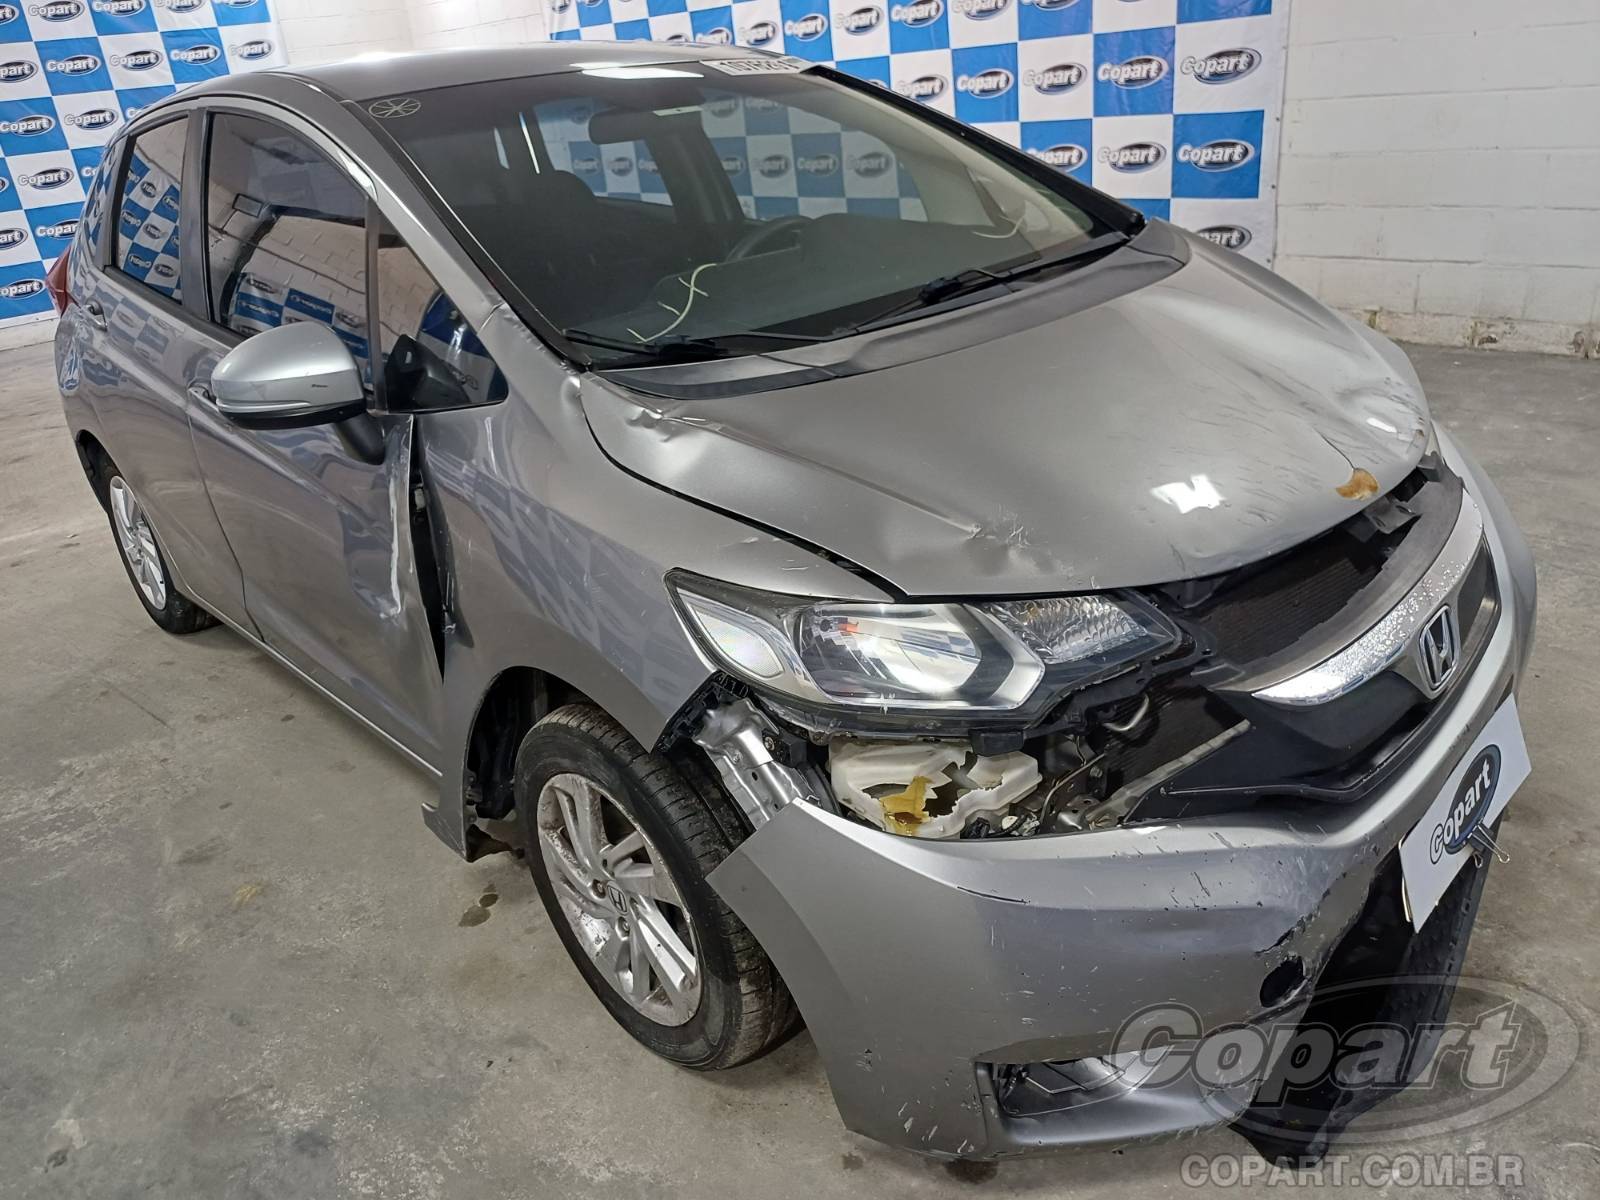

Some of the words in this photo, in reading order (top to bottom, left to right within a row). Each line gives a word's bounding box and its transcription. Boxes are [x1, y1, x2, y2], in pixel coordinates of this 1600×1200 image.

[28, 3, 77, 17] Copart
[891, 2, 939, 24] Copart
[784, 17, 823, 39] Copart
[110, 53, 159, 69] Copart
[170, 47, 216, 62] Copart
[46, 58, 95, 73] Copart
[1097, 59, 1158, 82] Copart
[1181, 51, 1251, 77] Copart
[956, 74, 1007, 94] Copart
[1022, 67, 1079, 88] Copart
[0, 118, 49, 134] Copart
[64, 111, 112, 127] Copart
[1098, 144, 1158, 166] Copart
[1177, 144, 1245, 165] Copart
[19, 171, 68, 187] Copart
[36, 222, 78, 237] Copar
[0, 280, 41, 297] opart
[1430, 758, 1490, 865] Copart
